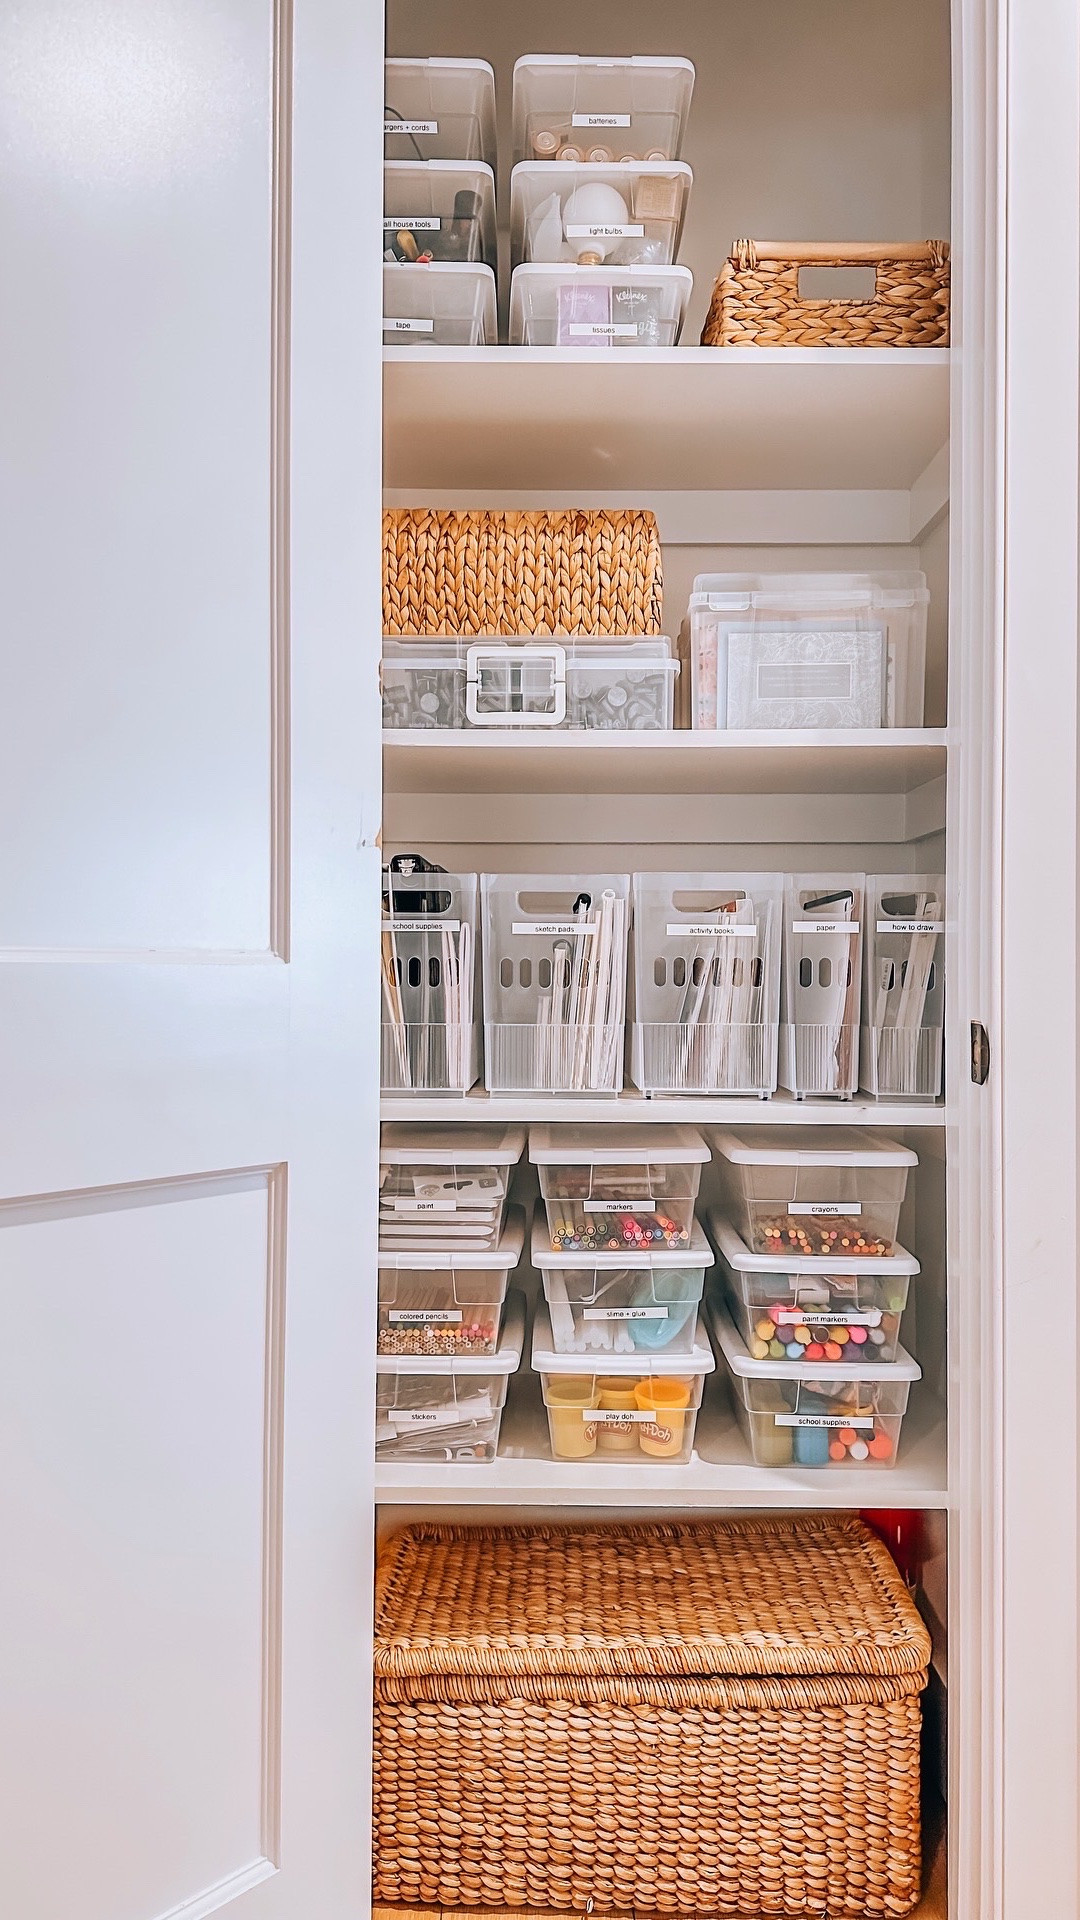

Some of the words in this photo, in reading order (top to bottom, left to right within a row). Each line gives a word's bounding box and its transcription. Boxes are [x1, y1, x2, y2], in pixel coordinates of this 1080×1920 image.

[588, 117, 617, 125] batteries
[589, 227, 604, 236] light
[604, 227, 623, 235] bulbs
[395, 321, 411, 329] tape
[592, 326, 615, 334] tissues
[415, 923, 443, 931] supplies
[557, 926, 575, 934] pads
[689, 927, 713, 935] activity
[606, 1203, 633, 1211] markers
[425, 1313, 449, 1321] pencils
[631, 1310, 646, 1318] glue
[802, 1315, 819, 1323] paint
[820, 1315, 848, 1323] markers
[605, 1413, 620, 1421] play
[798, 1418, 821, 1426] school
[822, 1419, 851, 1427] supplies
